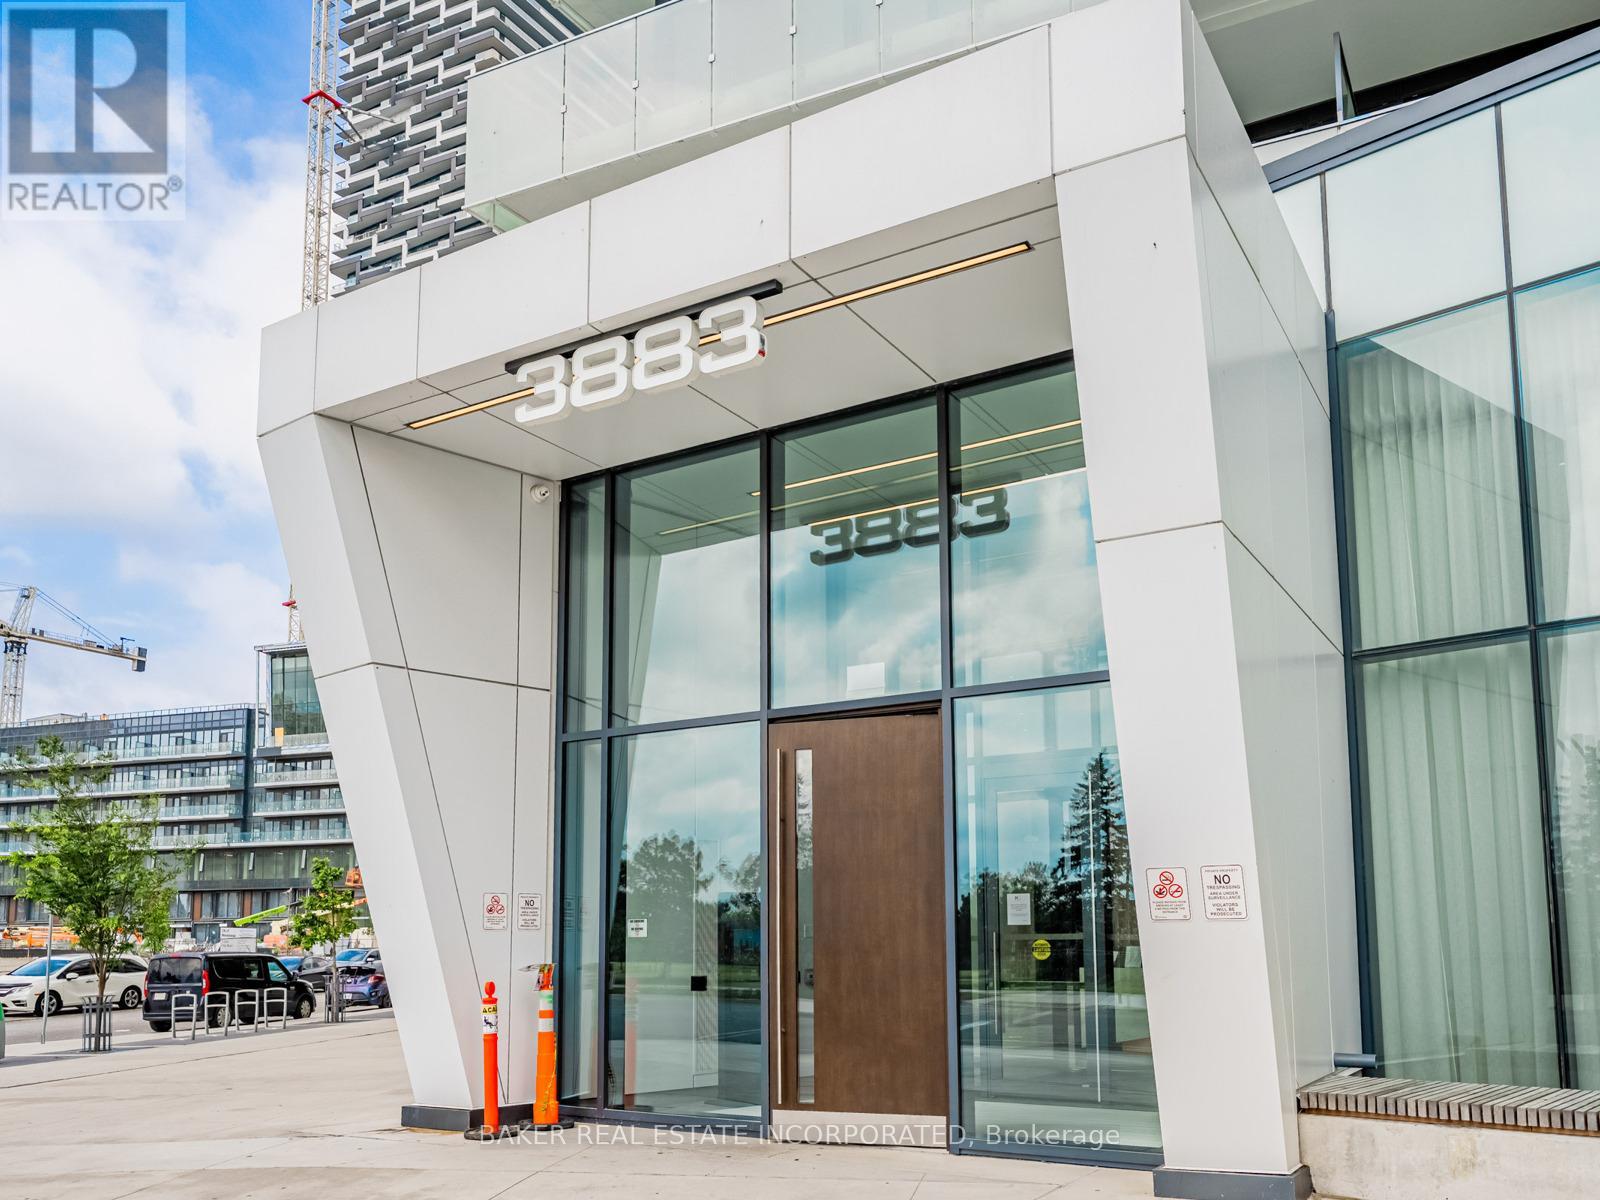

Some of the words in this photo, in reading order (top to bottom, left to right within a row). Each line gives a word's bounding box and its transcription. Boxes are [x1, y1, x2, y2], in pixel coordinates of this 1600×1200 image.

[514, 295, 766, 425] 3883
[1214, 874, 1231, 885] NO
[524, 899, 535, 907] NO
